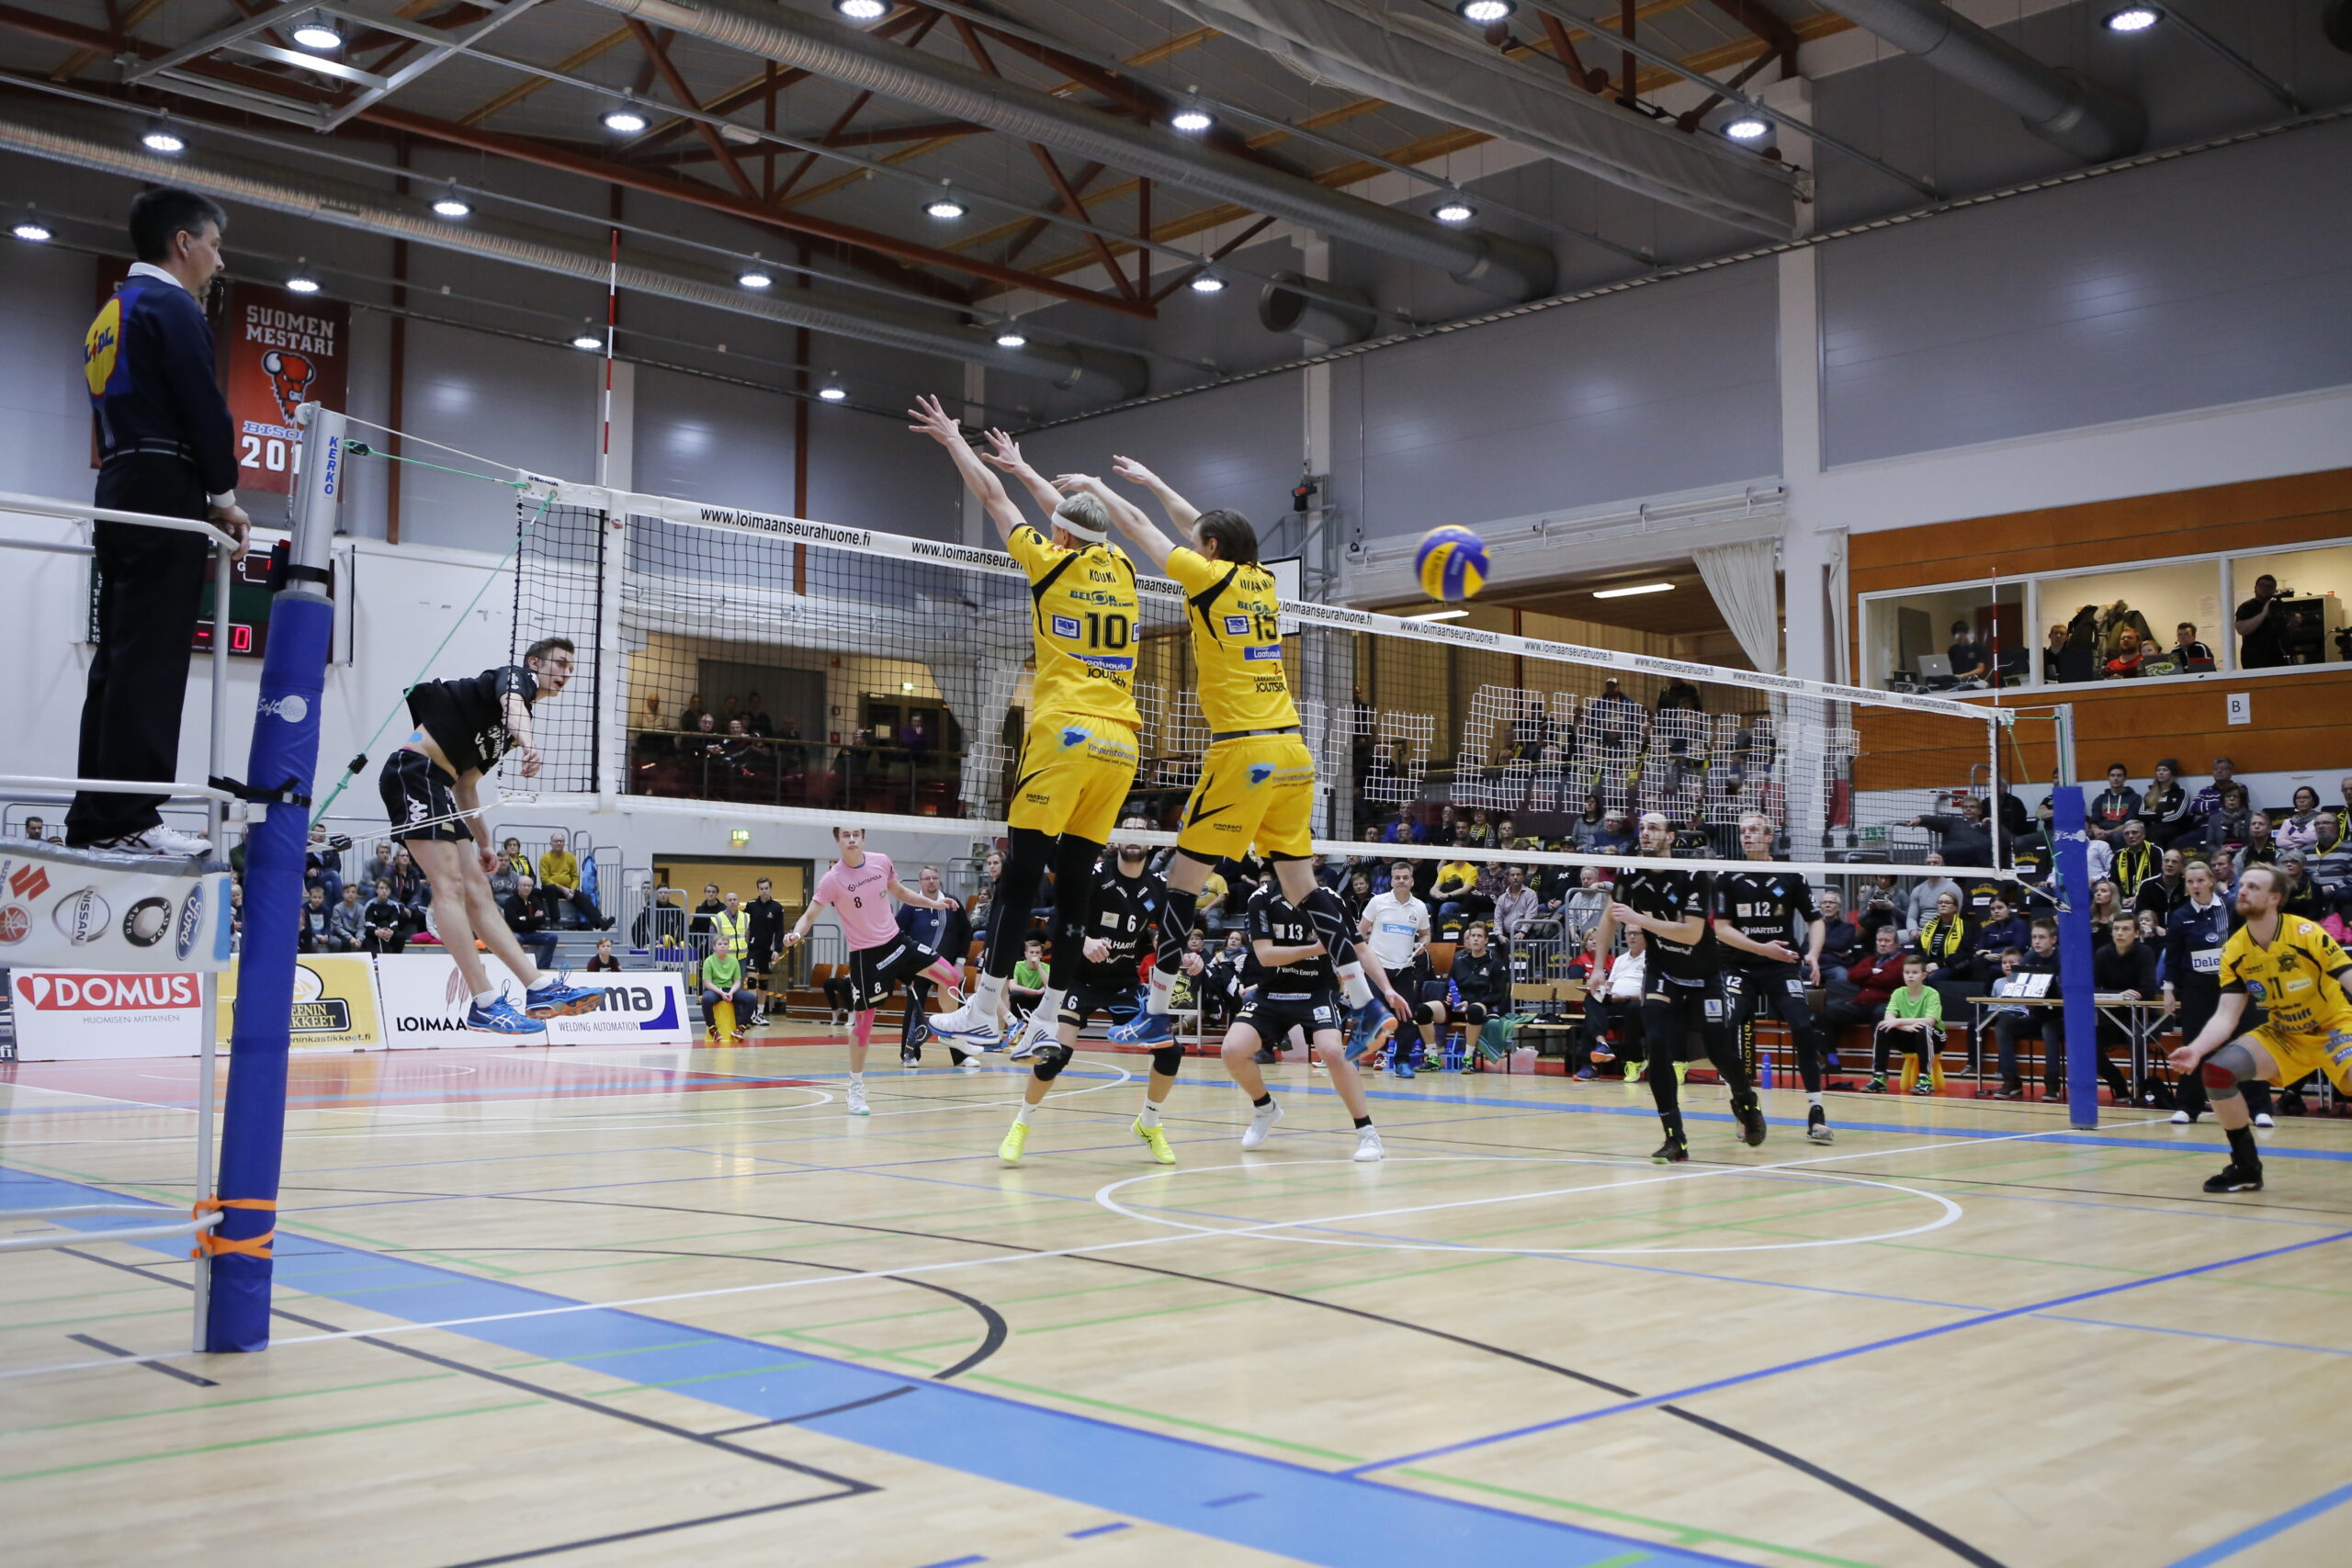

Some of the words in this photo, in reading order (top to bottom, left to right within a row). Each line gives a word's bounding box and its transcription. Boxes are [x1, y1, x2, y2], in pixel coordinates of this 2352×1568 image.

[245, 304, 334, 338] SUOMEN
[245, 324, 334, 356] MESTARI
[243, 421, 303, 440] BISO
[240, 435, 303, 475] 201
[323, 435, 338, 495] KERKO
[700, 508, 871, 547] www.loimaanseurahuone.fi
[1085, 611, 1128, 650] 10
[1254, 614, 1278, 640] 15
[1399, 619, 1500, 645] www.loimaanseurahuone.fi
[1523, 640, 1613, 662] www.loimaanseurahuone.fi
[1087, 668, 1126, 688] JOUTSEN
[2232, 701, 2241, 713] B
[854, 897, 862, 908] 8
[1755, 901, 1770, 917] 12
[76, 890, 94, 942] NISSAN
[125, 907, 140, 934] AUTO
[179, 896, 202, 946] Ford
[1126, 914, 1136, 932] 6
[1287, 923, 1304, 941] 13
[1749, 925, 1784, 934] HARTELA
[2193, 957, 2220, 969] Dele
[55, 976, 192, 1008] DOMUS
[600, 987, 653, 1011] ma
[874, 982, 882, 994] 8
[1067, 995, 1079, 1010] 6
[83, 1015, 131, 1024] HUOMISEN
[133, 1014, 180, 1023] MITTAINEN
[559, 1021, 592, 1032] WELDING
[593, 1021, 639, 1032] AUTOMATION
